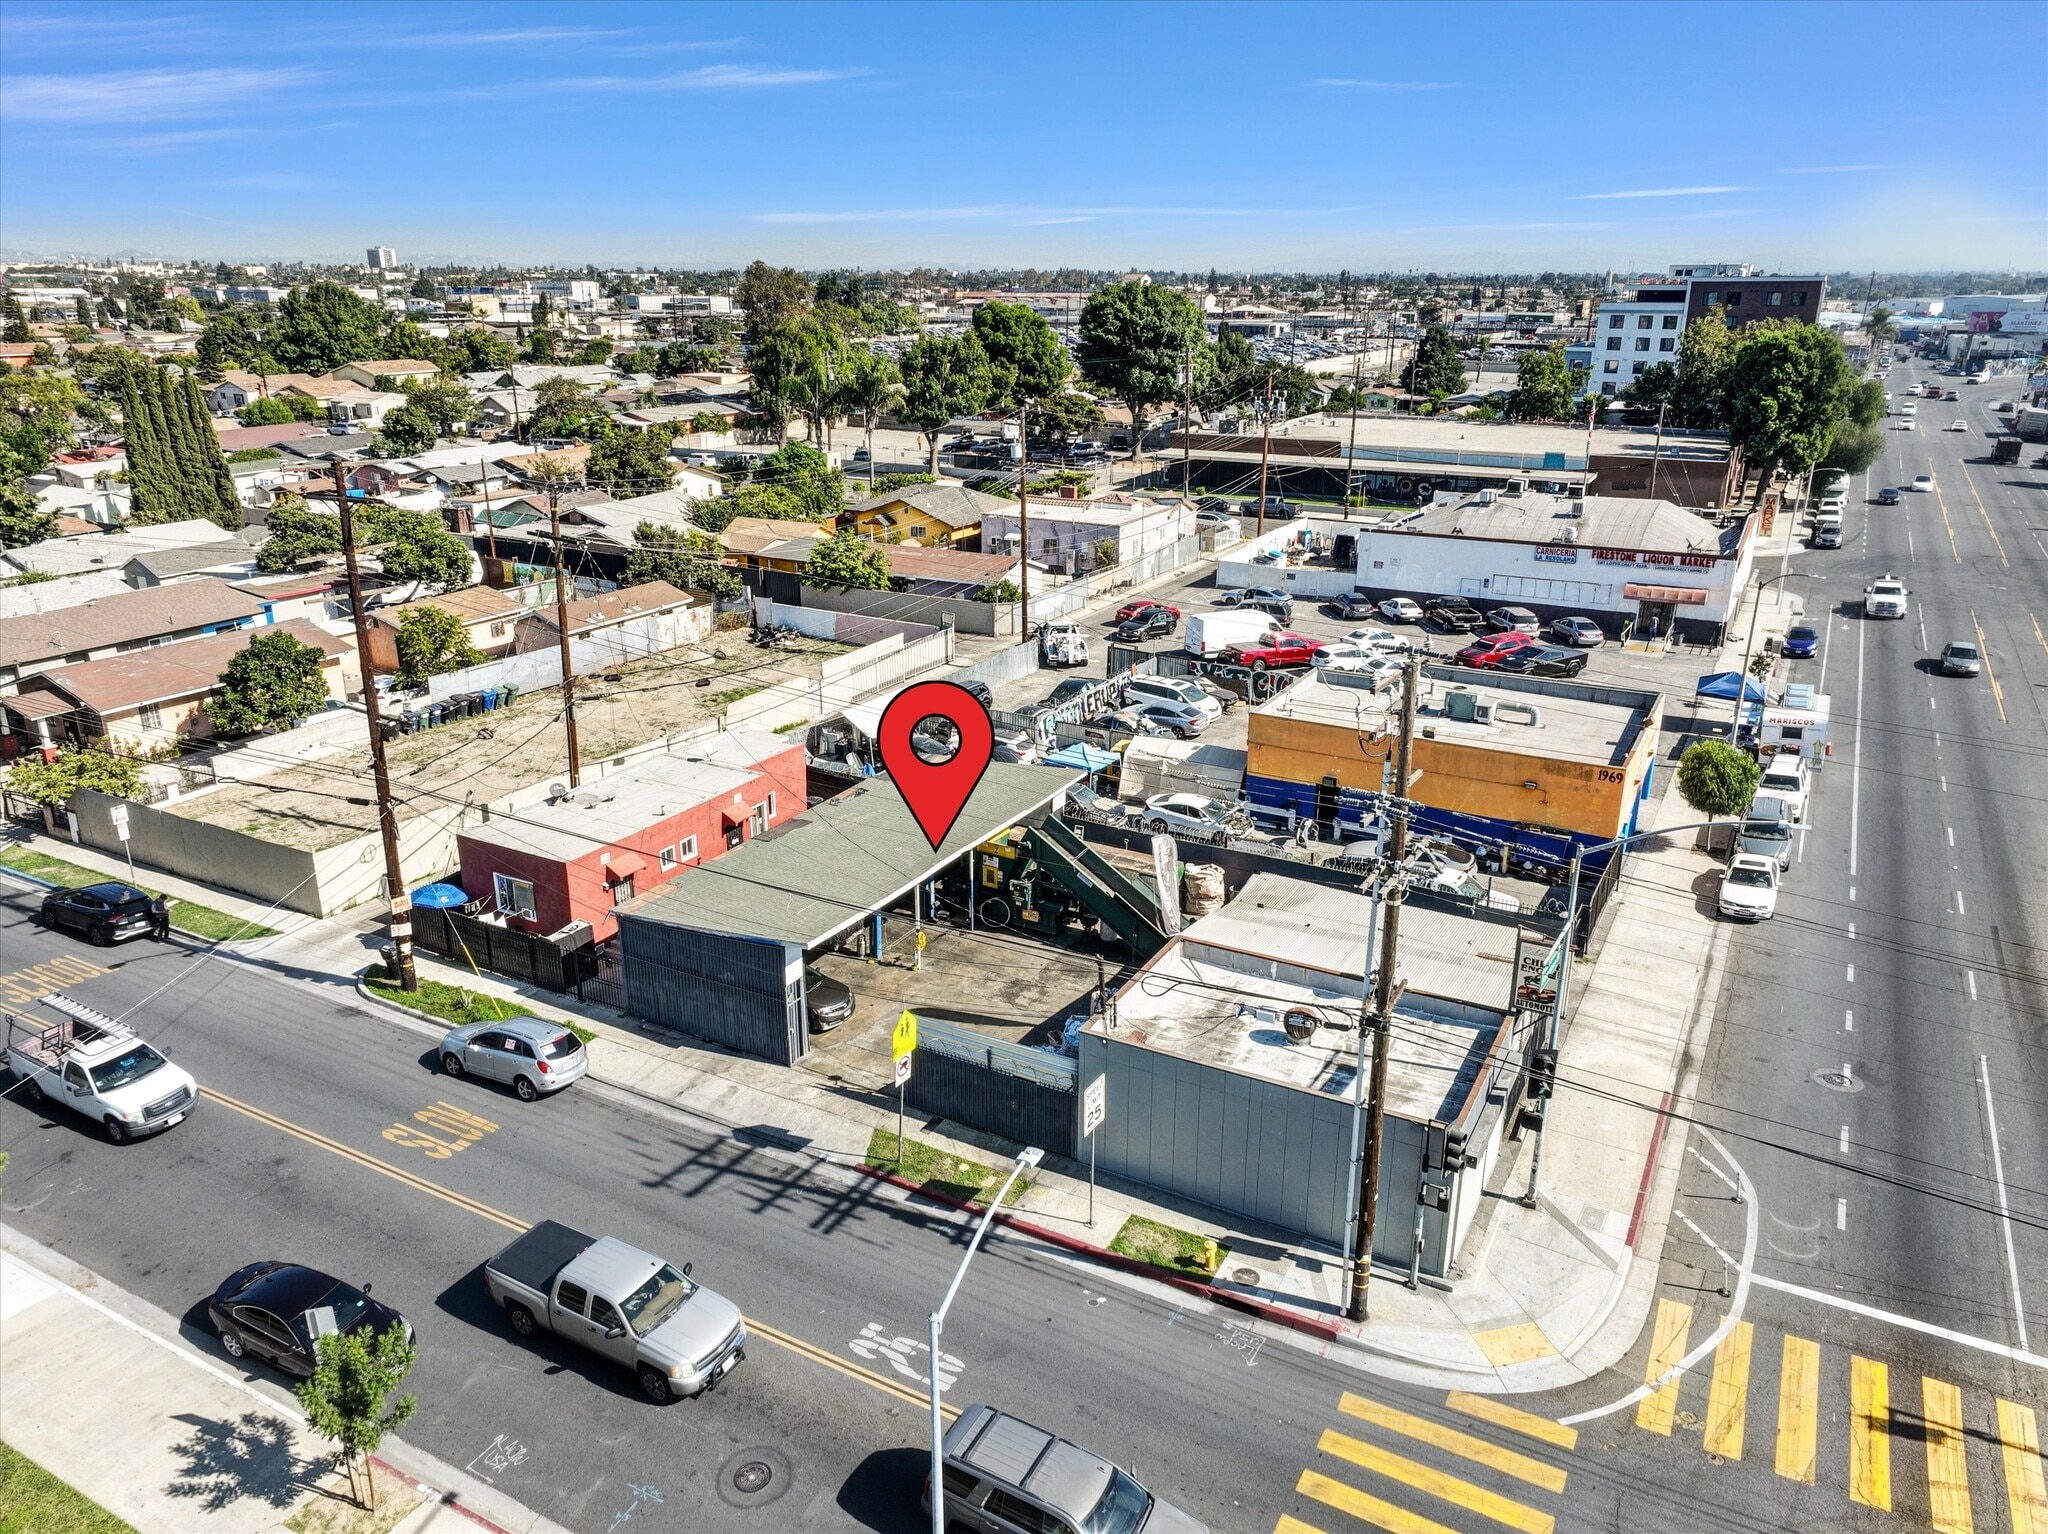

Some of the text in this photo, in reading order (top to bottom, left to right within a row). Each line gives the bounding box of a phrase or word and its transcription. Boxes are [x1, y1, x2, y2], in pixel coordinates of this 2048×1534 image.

[1762, 498, 1776, 535] MARKET
[1536, 546, 1575, 557] CARNICERIA
[1591, 550, 1717, 569] FIRESTONE LIQUOR MARKET
[1768, 717, 1816, 726] MARISCOS
[1597, 769, 1624, 784] 1969
[1515, 999, 1557, 1013] AUTOMOTI
[1086, 1081, 1104, 1100] SPEED
[1087, 1092, 1102, 1110] LIMIT
[1086, 1103, 1102, 1129] 25
[381, 1100, 500, 1159] SLOW
